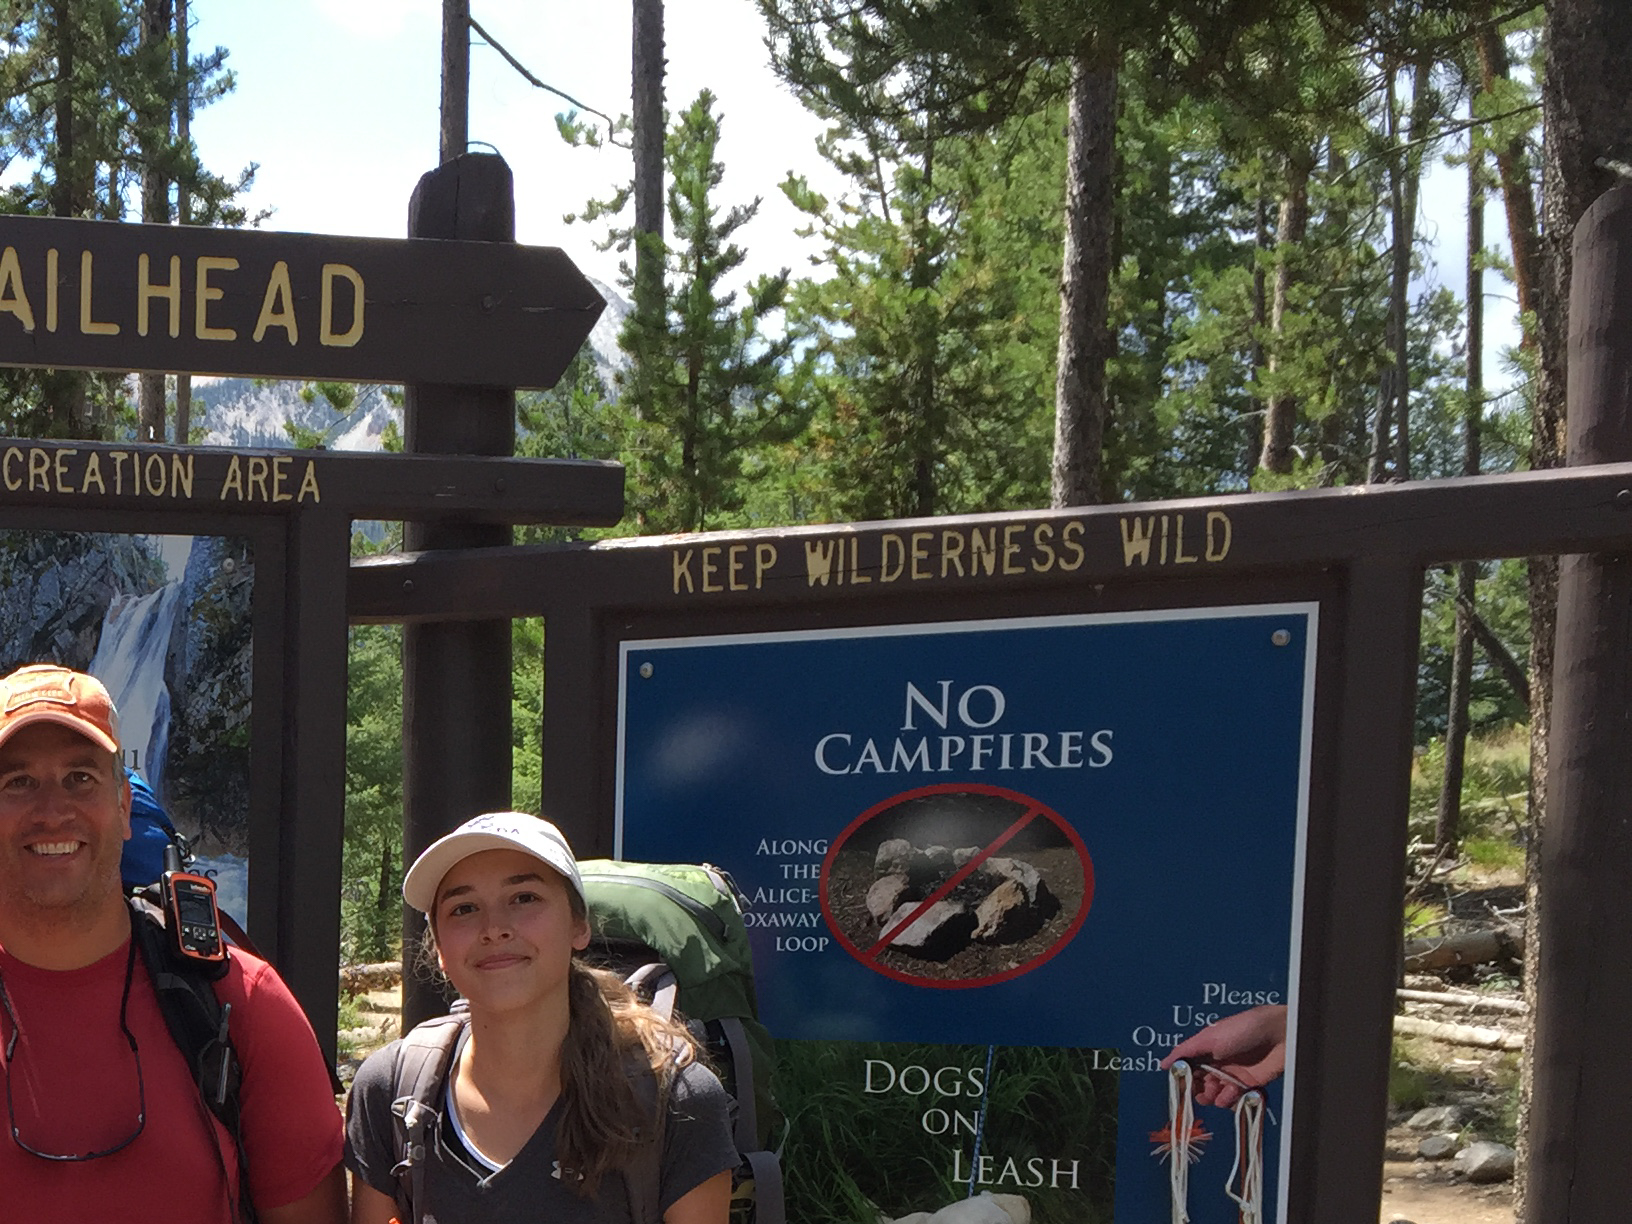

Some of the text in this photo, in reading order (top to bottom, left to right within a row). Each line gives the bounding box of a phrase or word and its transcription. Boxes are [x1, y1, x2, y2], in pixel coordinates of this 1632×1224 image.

[220, 454, 321, 503] AREA
[672, 510, 1232, 596] KEEP WILDERNESS WILD
[899, 679, 1006, 732] NO
[814, 730, 1115, 776] CAMPFIRES
[755, 838, 828, 856] ALONG
[779, 863, 822, 879] THE
[752, 886, 820, 904] ALICE-
[743, 912, 822, 928] OXAWAY
[776, 936, 829, 952] LOOP
[1202, 982, 1281, 1006] Please
[1172, 1005, 1219, 1028] Use
[1132, 1025, 1184, 1048] Our
[1091, 1050, 1163, 1073] Leash
[863, 1059, 986, 1099] DOGS
[922, 1107, 980, 1137] ON
[952, 1149, 1082, 1190] LEASH
